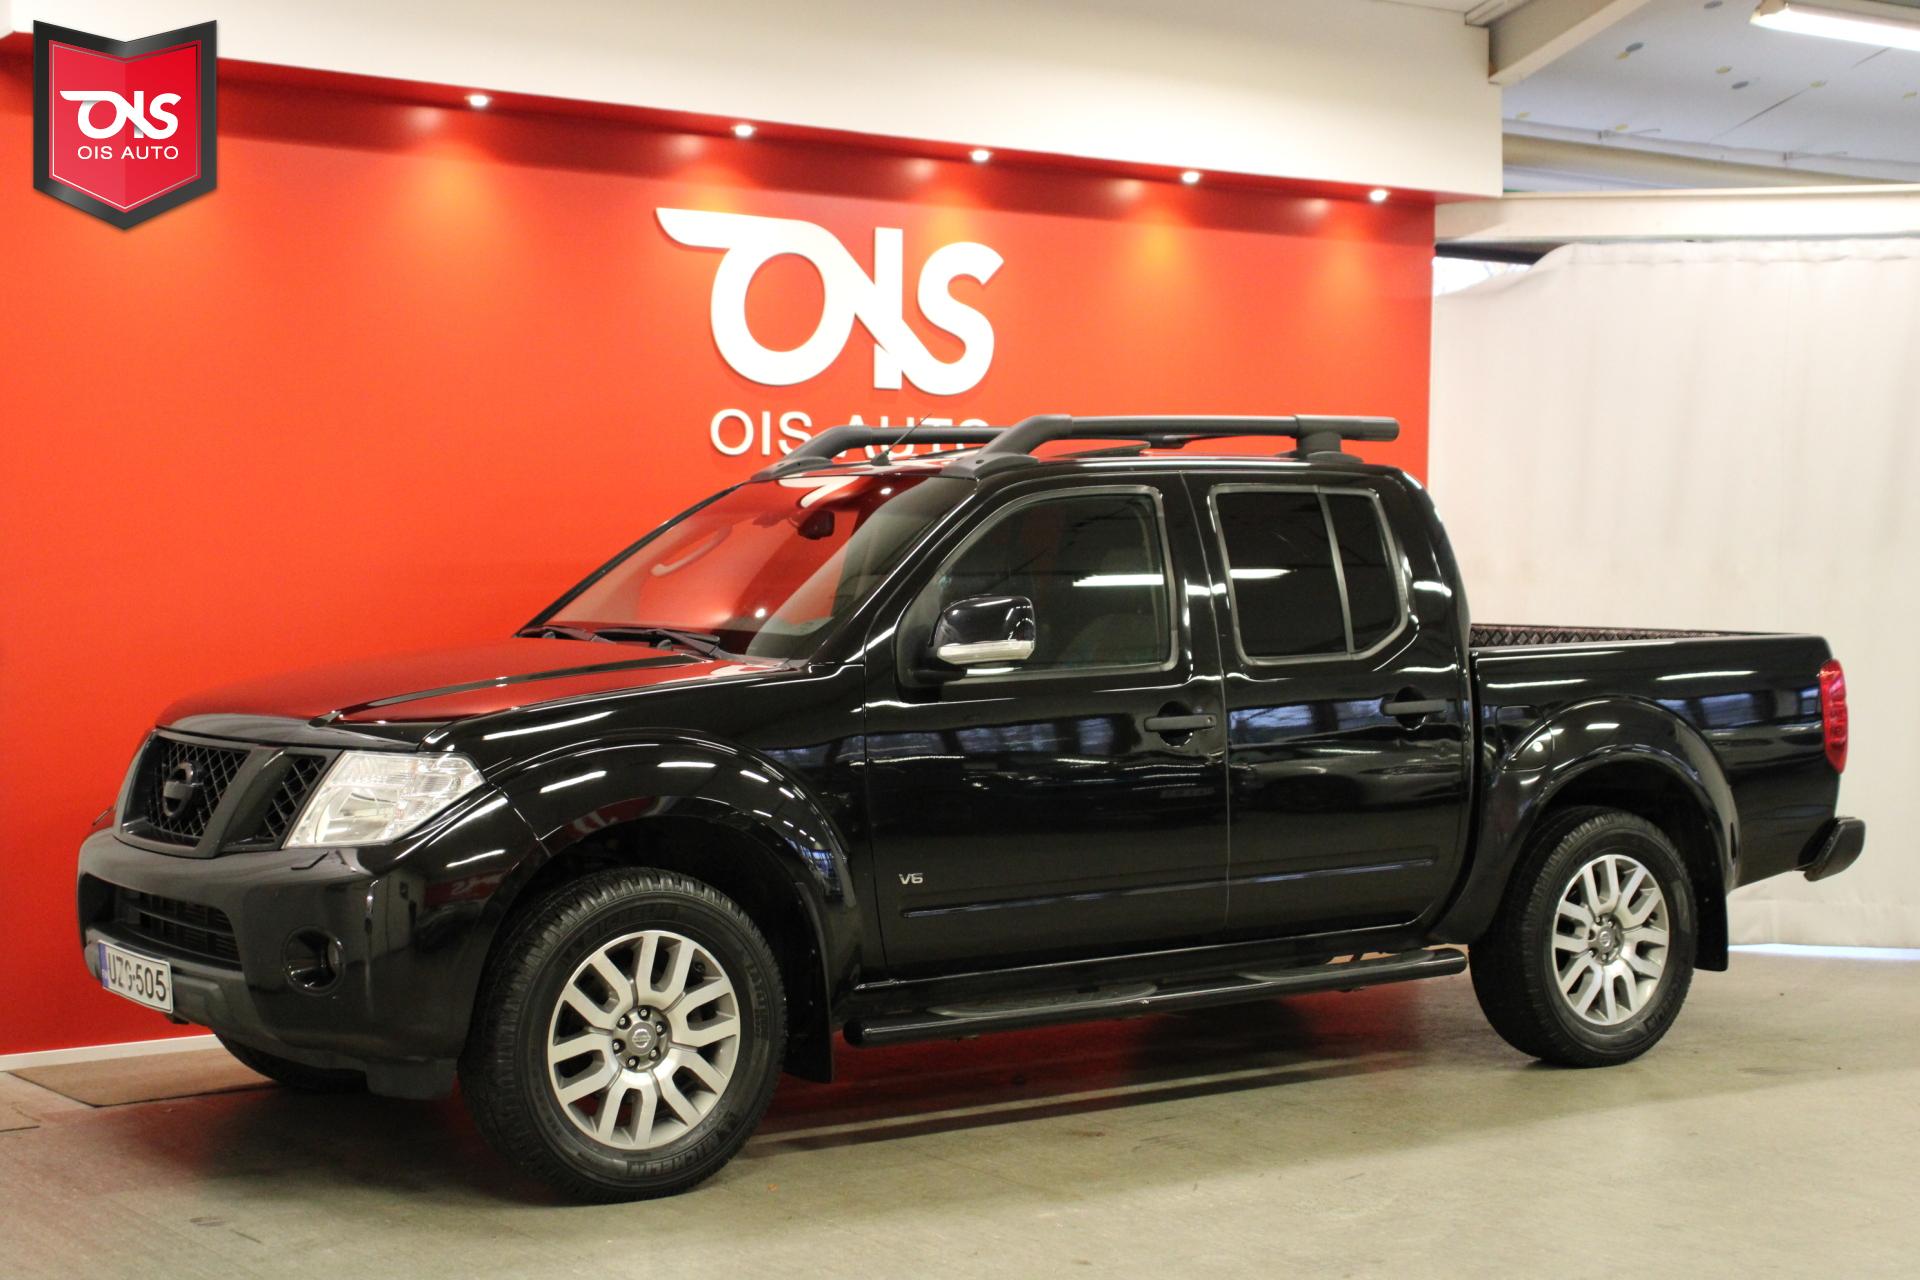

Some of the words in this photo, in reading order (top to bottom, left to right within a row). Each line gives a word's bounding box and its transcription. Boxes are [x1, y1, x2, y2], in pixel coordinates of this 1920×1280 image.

[655, 207, 1004, 396] OIS
[710, 409, 813, 456] OIS
[898, 872, 924, 885] V6
